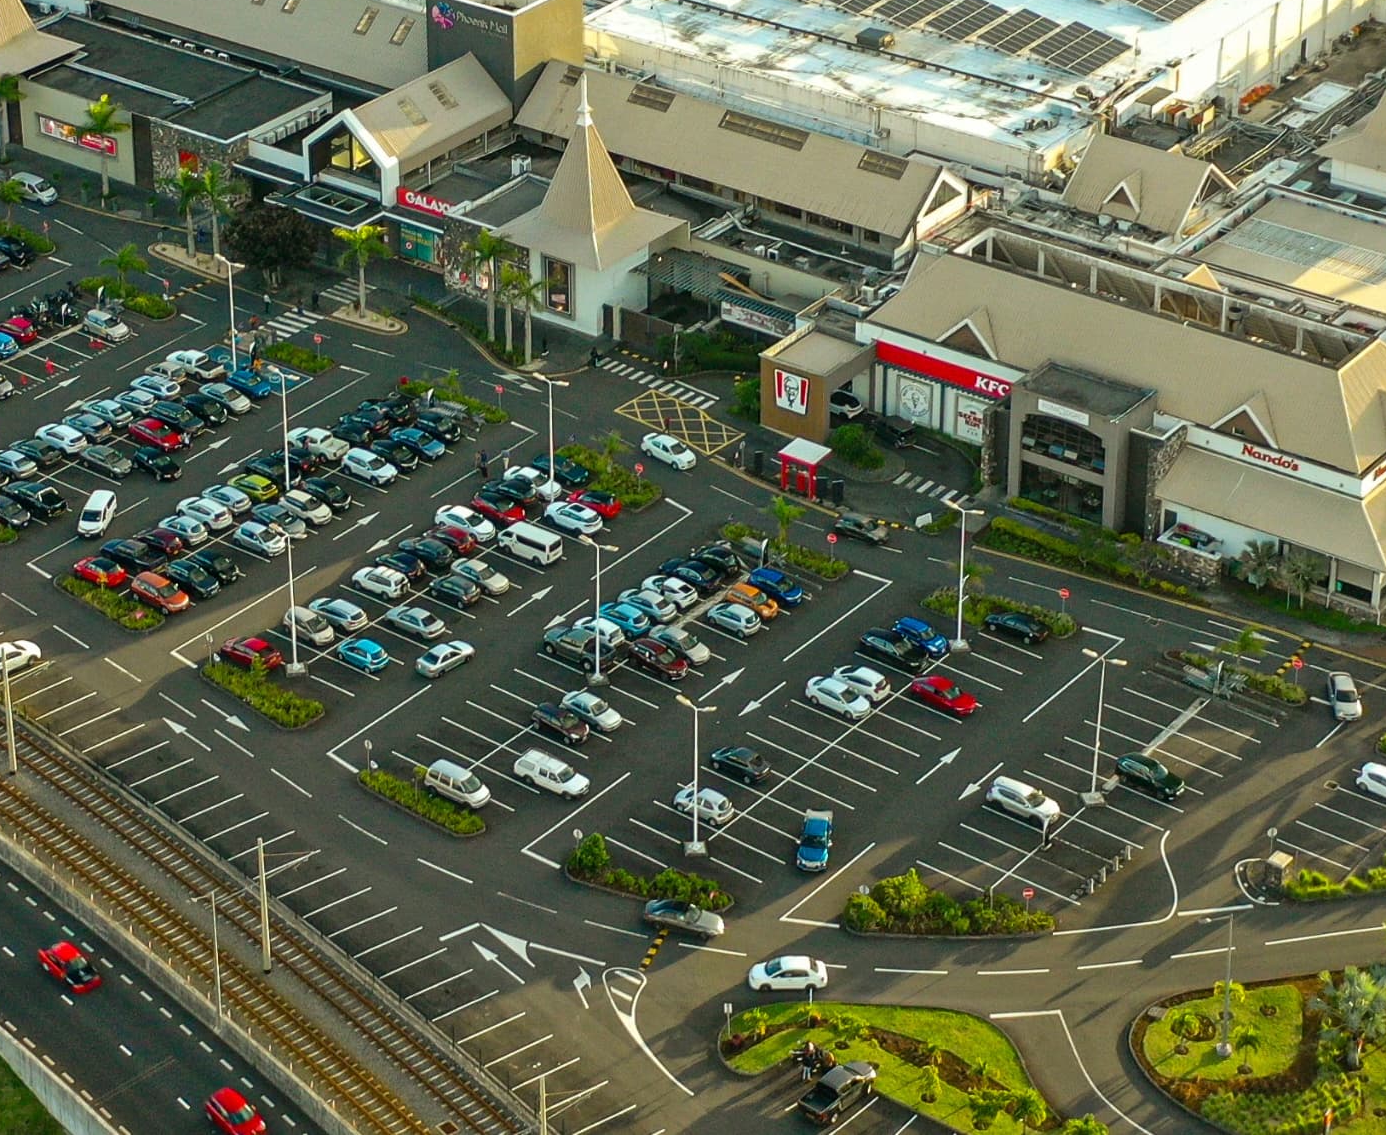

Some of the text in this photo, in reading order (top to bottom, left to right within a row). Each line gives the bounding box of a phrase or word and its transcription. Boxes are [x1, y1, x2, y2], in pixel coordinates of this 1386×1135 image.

[456, 10, 489, 30] Phoenix
[490, 19, 508, 34] Mall
[405, 191, 451, 216] GALAX
[975, 375, 1010, 397] KFC
[1241, 443, 1300, 472] Nando's
